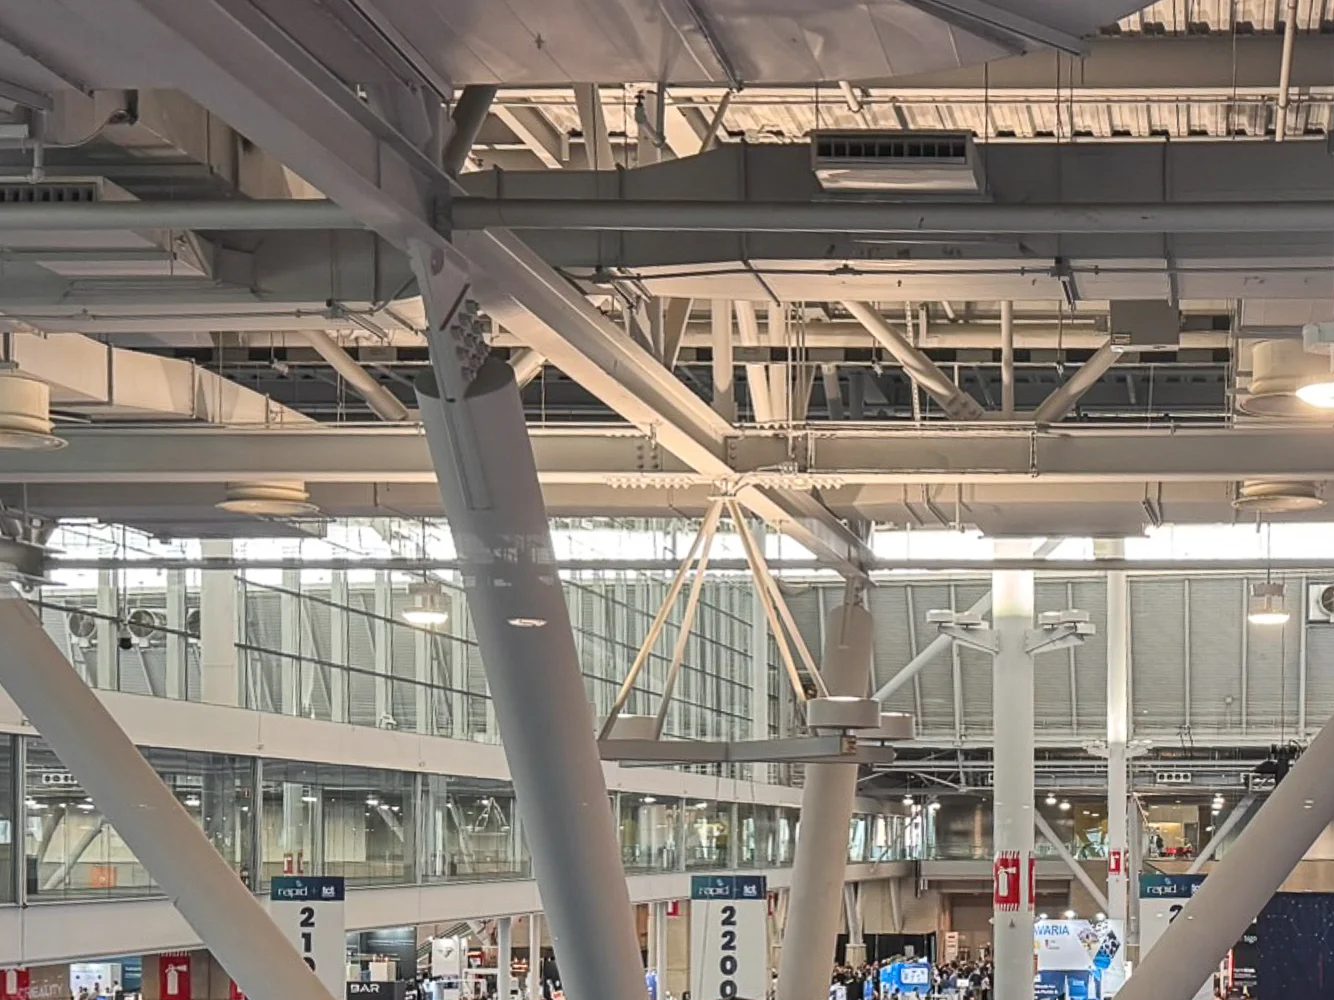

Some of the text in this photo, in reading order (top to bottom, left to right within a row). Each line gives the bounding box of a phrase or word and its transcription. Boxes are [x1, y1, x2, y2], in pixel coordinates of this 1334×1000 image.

[278, 886, 308, 898] rapid
[699, 885, 729, 897] rapid
[1146, 884, 1177, 895] rapid
[719, 905, 738, 999] 2200
[350, 984, 380, 993] BAR
